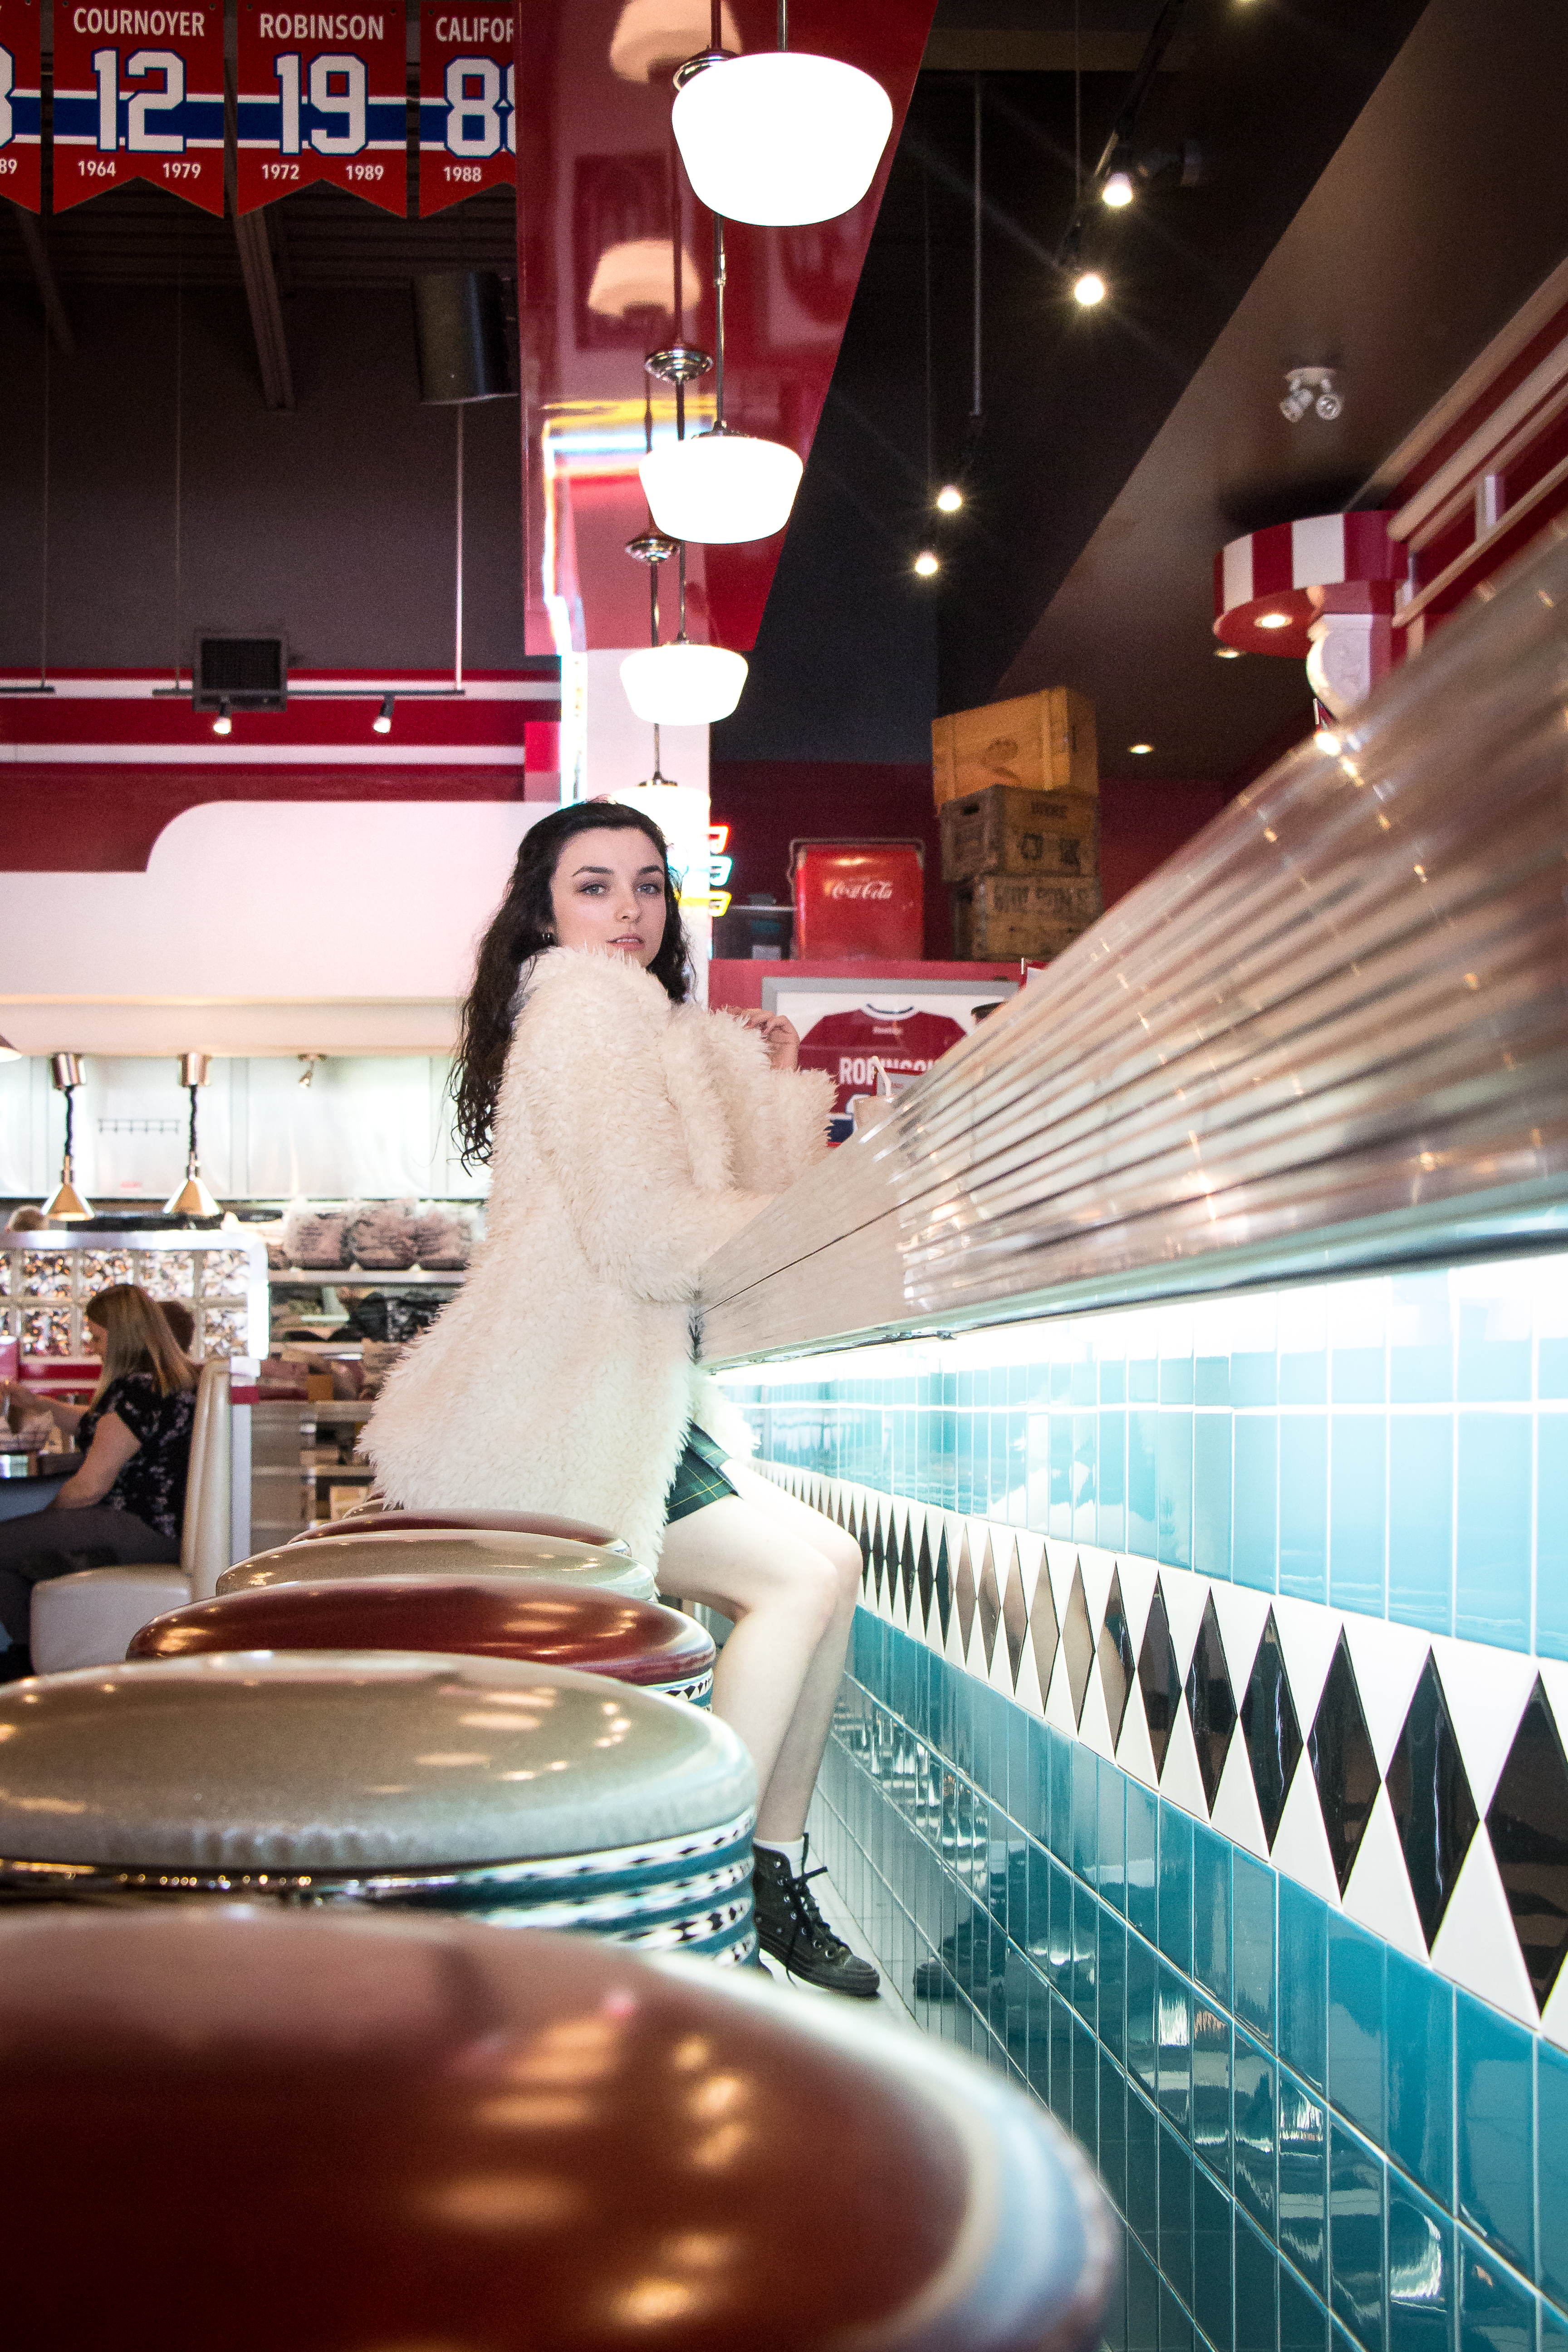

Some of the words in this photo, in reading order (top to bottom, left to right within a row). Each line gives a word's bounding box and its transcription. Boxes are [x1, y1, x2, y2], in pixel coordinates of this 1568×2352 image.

[73, 8, 205, 36] COURNOYER
[260, 13, 384, 40] ROBINSON
[93, 48, 185, 152] 12
[275, 53, 367, 155] 19
[445, 56, 516, 158] 8
[78, 160, 116, 177] 1964
[162, 162, 201, 179] 1979
[262, 164, 300, 180] 1972
[346, 164, 384, 181] 1989
[443, 166, 482, 182] 1988
